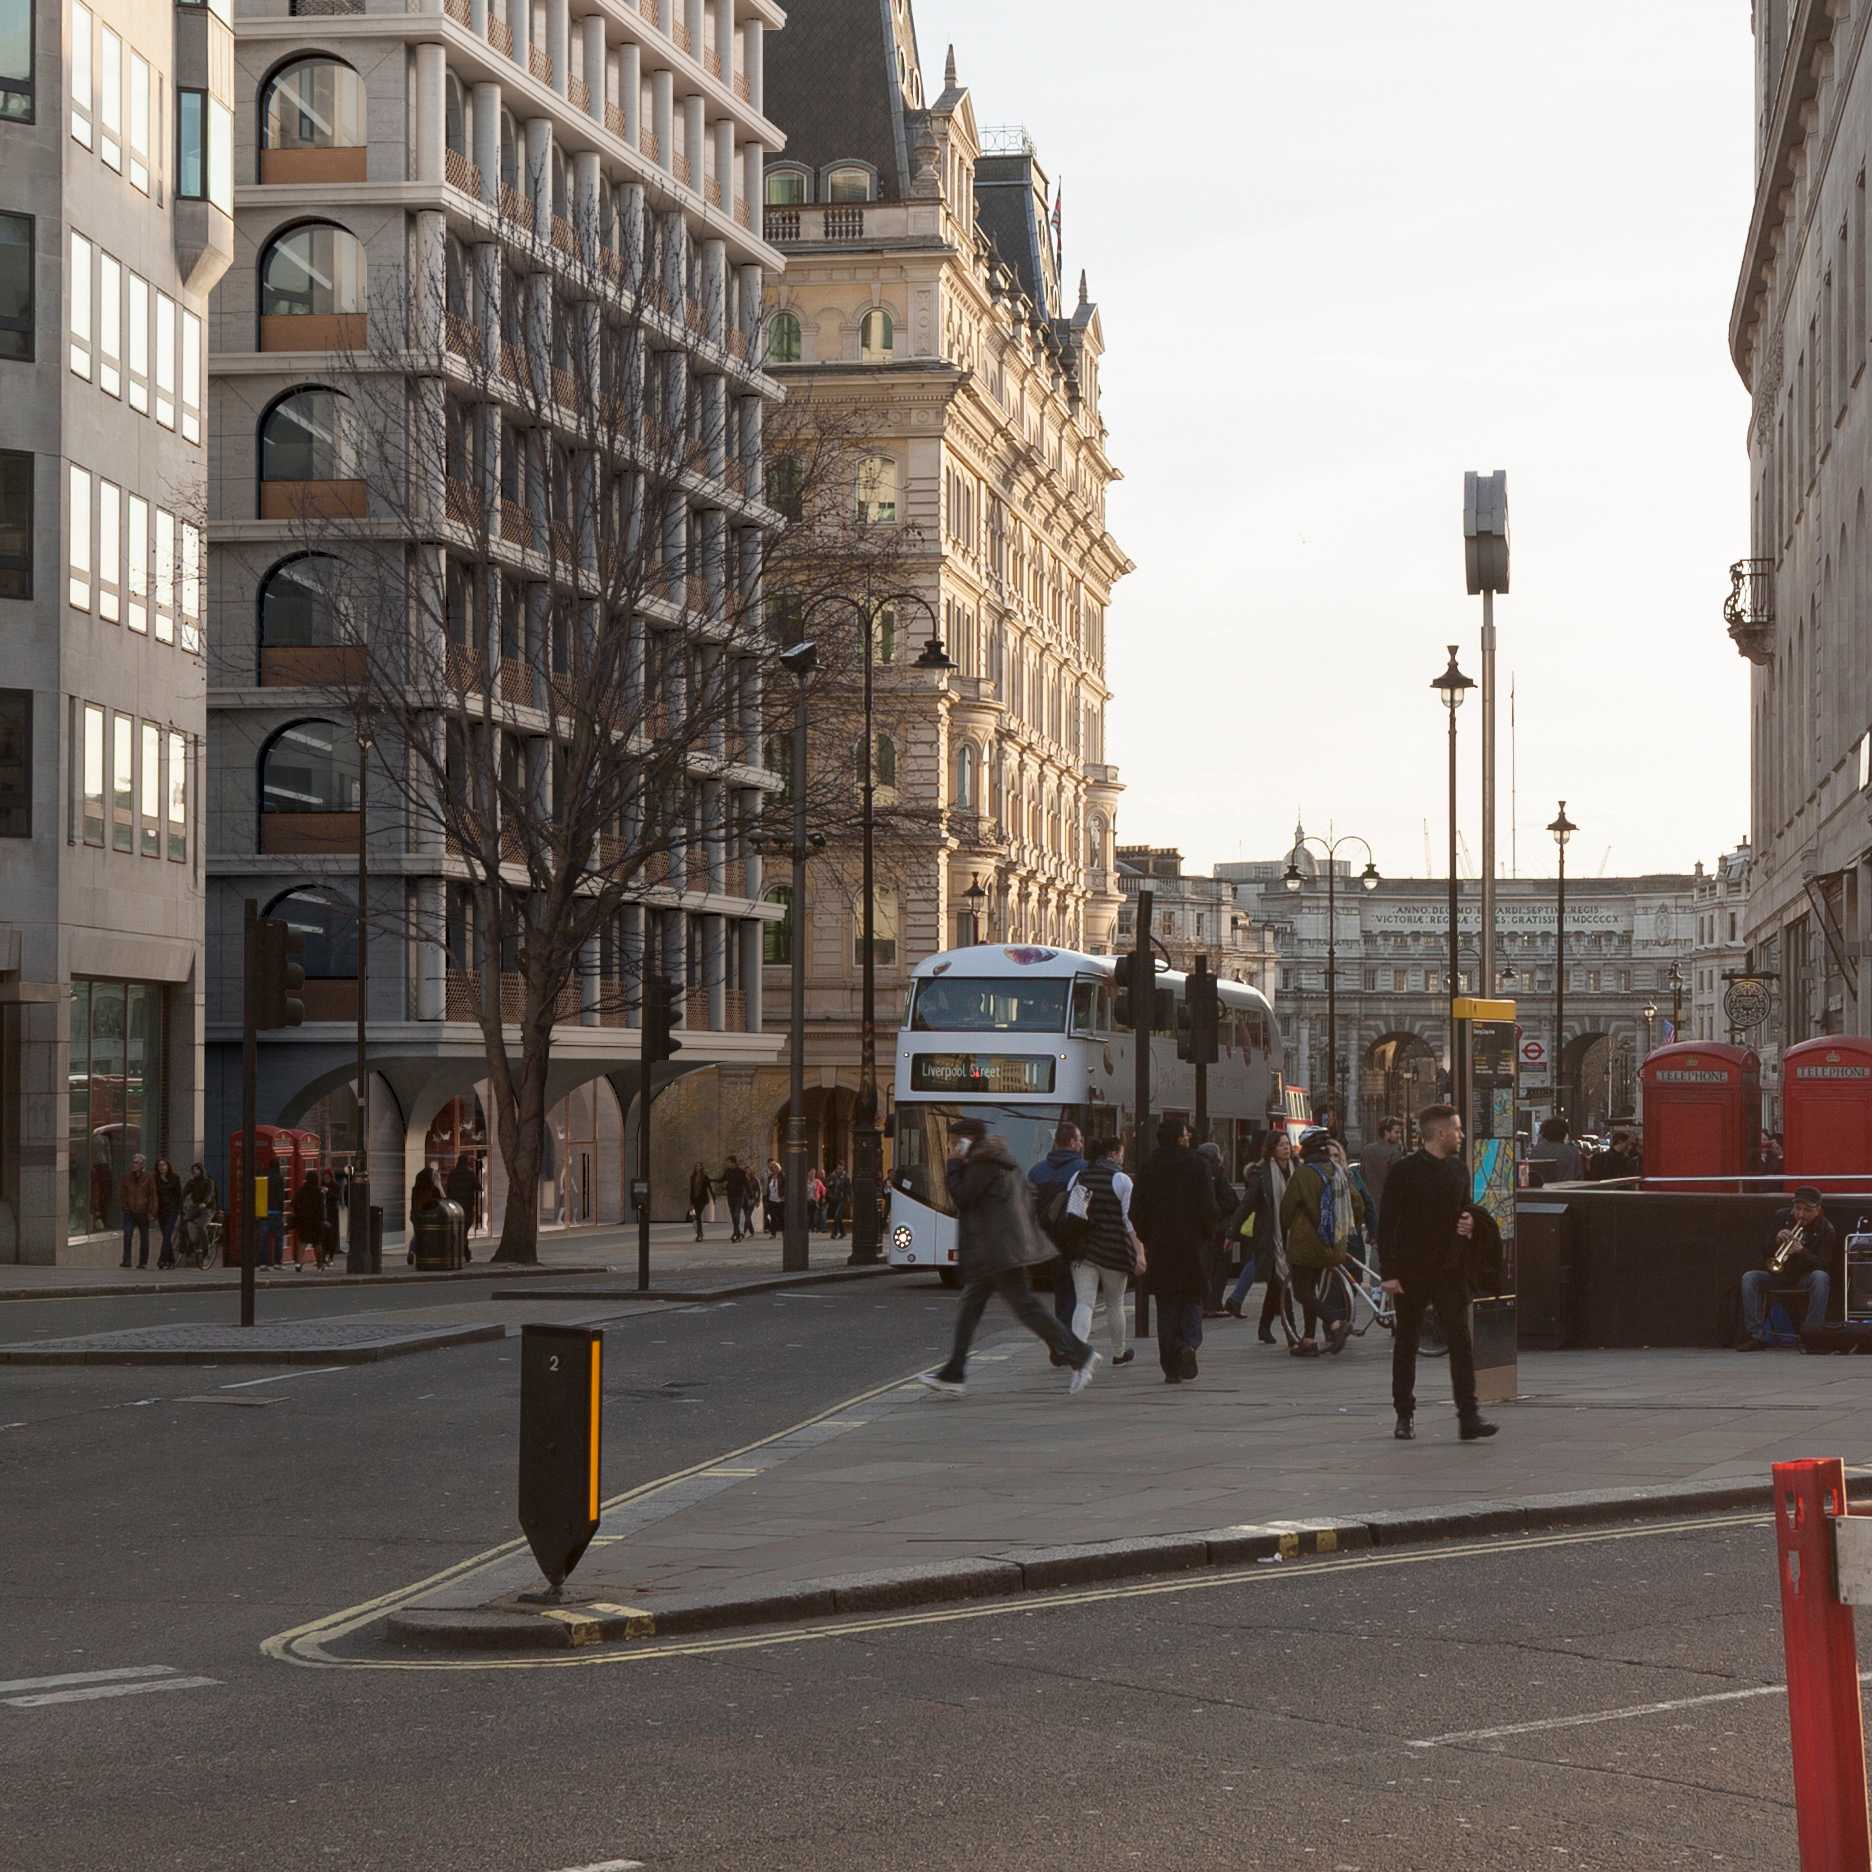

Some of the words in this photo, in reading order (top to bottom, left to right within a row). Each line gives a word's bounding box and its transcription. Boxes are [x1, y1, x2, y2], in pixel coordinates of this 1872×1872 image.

[922, 1063, 966, 1080] Liverpool
[969, 1063, 1001, 1078] Street
[1659, 1071, 1727, 1082] TELEPHONE
[1798, 1067, 1869, 1078] TELEPHONE
[549, 1355, 560, 1371] 2
